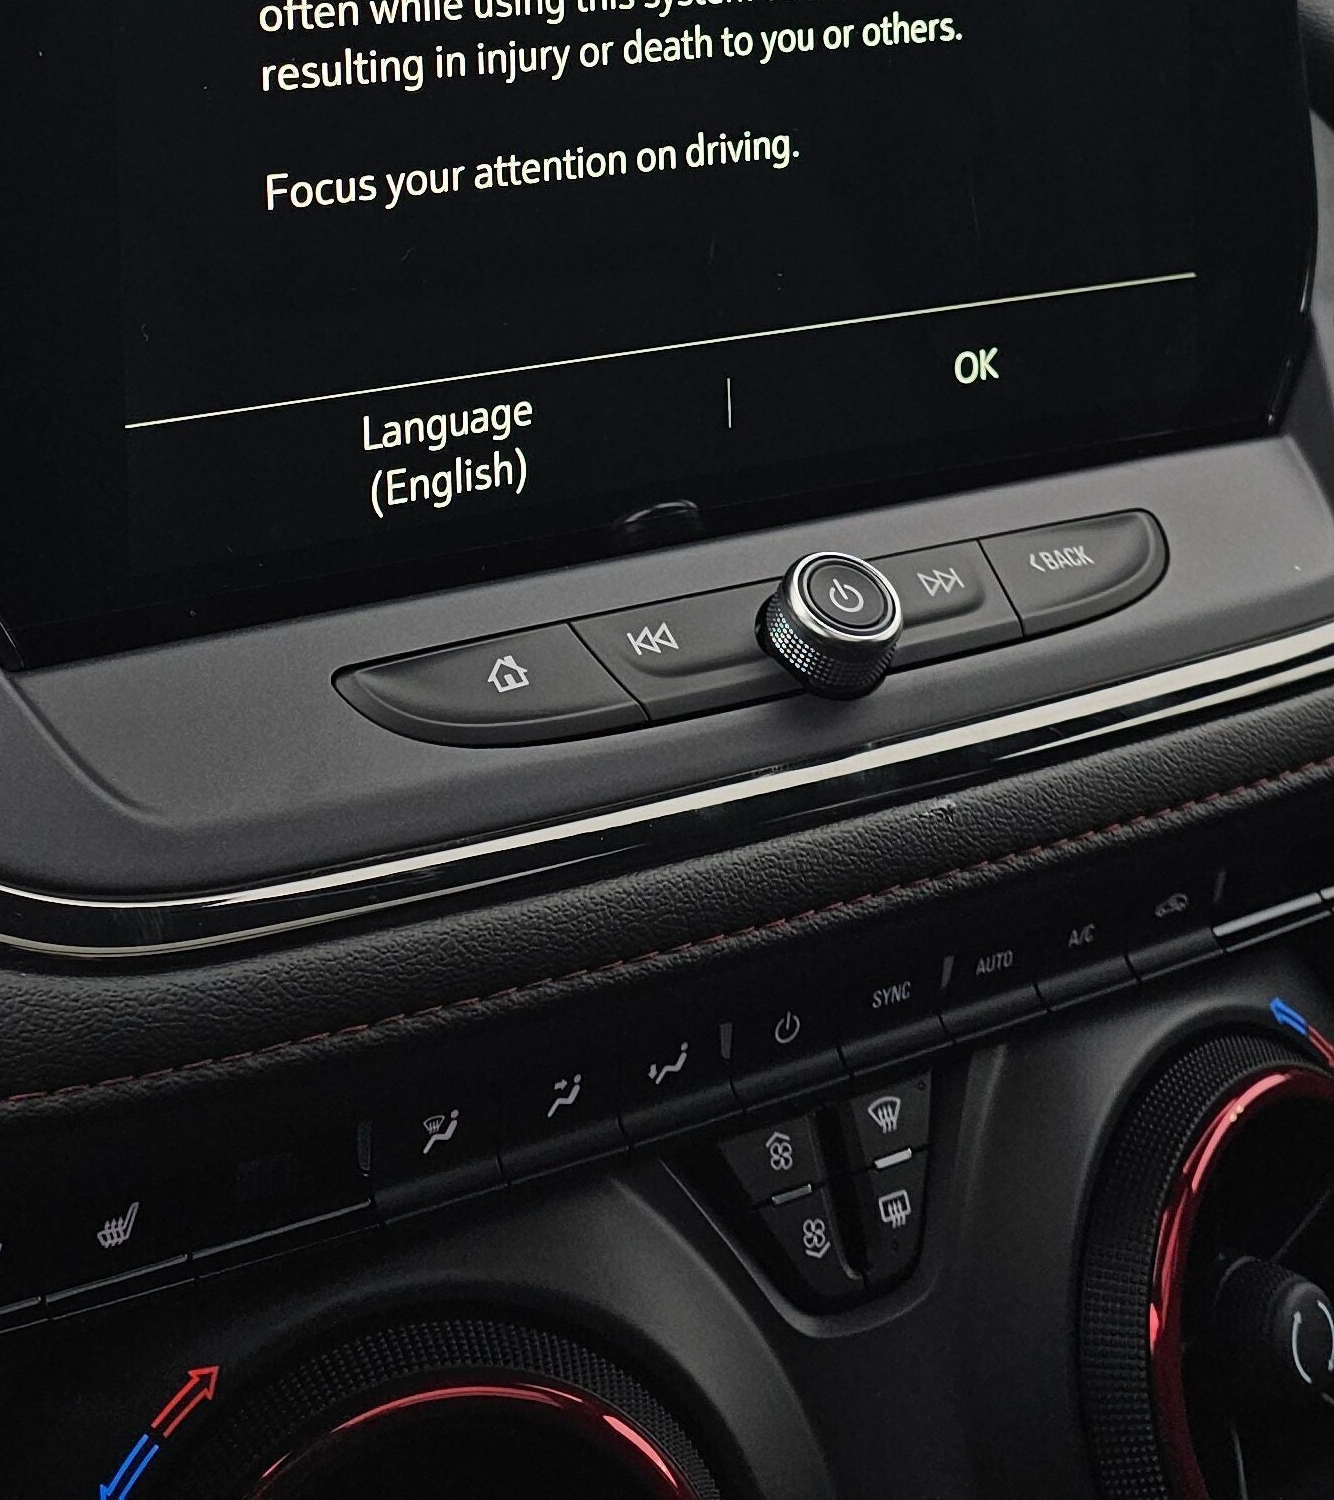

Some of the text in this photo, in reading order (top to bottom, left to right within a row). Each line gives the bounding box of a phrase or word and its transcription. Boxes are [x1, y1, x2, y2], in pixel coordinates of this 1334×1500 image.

[263, 11, 963, 92] resulting in injury or death to you or others.
[267, 131, 800, 210] Focus your attention on driving.
[954, 346, 1000, 384] OK
[363, 401, 533, 452] Language
[372, 448, 528, 518] (English)
[1068, 923, 1096, 948] A/C
[975, 950, 1014, 976] AUTO
[872, 980, 912, 1009] SYNC
